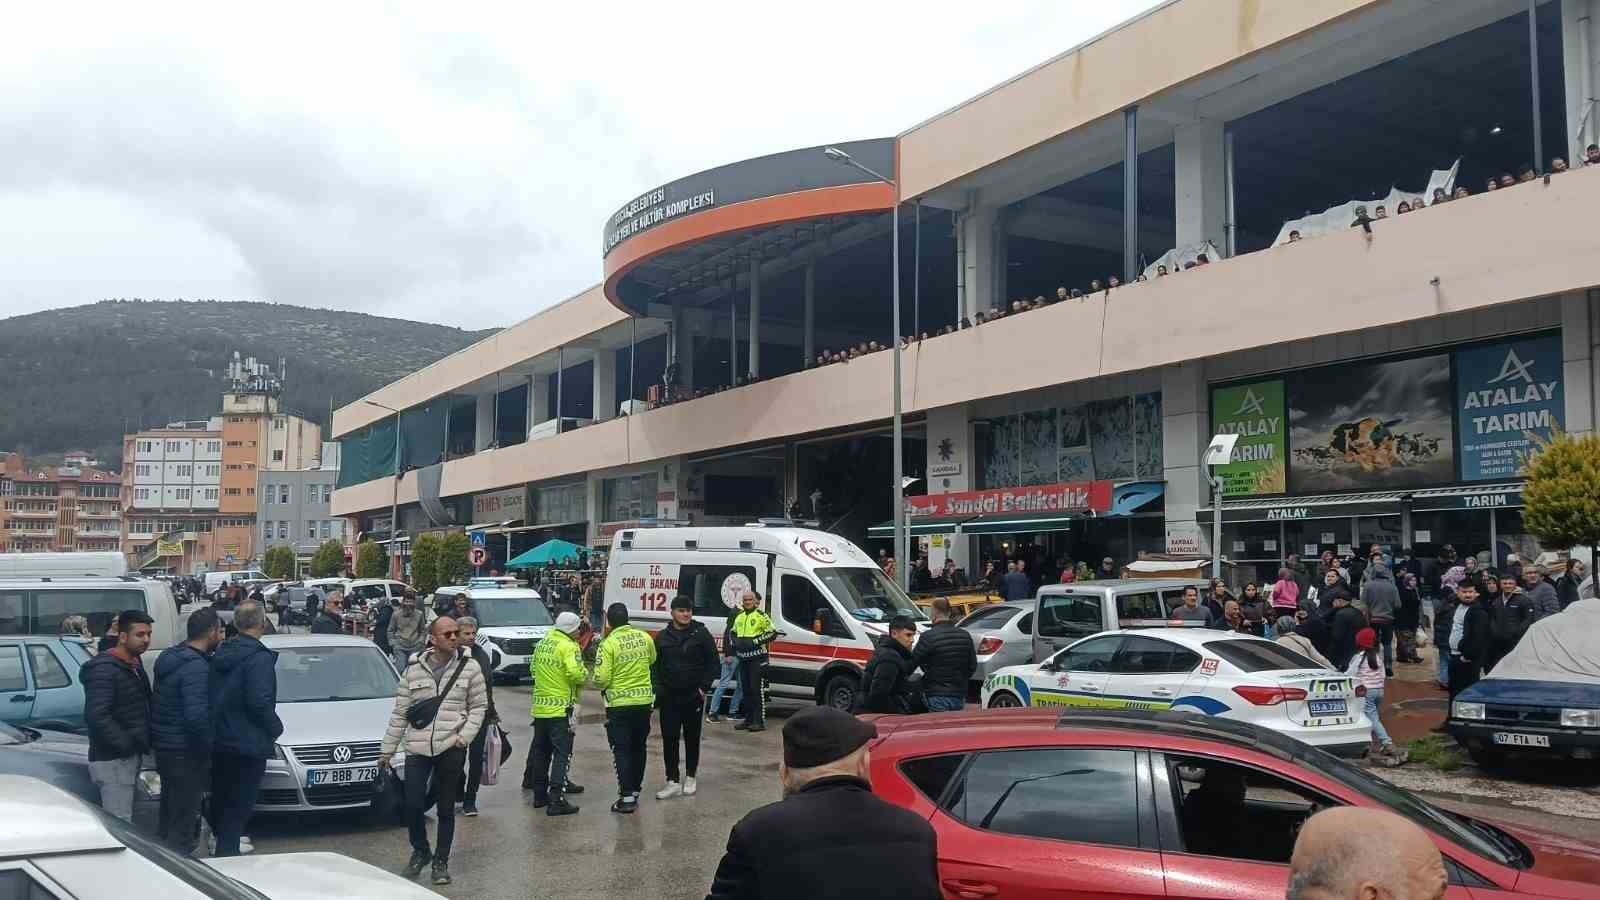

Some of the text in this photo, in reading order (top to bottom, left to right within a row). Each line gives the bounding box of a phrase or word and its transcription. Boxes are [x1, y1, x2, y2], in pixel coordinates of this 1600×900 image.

[640, 207, 664, 230] KÜLTÜR
[666, 189, 714, 218] KOMPLEKSİ
[1464, 381, 1557, 409] ATALAY
[1217, 417, 1280, 436] ATALAY
[1472, 410, 1550, 434] TARIM
[1231, 443, 1273, 462] ARIM
[944, 494, 999, 515] Sandal
[1463, 495, 1507, 507] TARIM
[1267, 508, 1308, 520] ATALAY
[809, 546, 833, 556] 112
[622, 576, 647, 589] SAĞLIK
[640, 592, 667, 612] 112
[314, 771, 328, 783] 07
[332, 769, 352, 782] BBB
